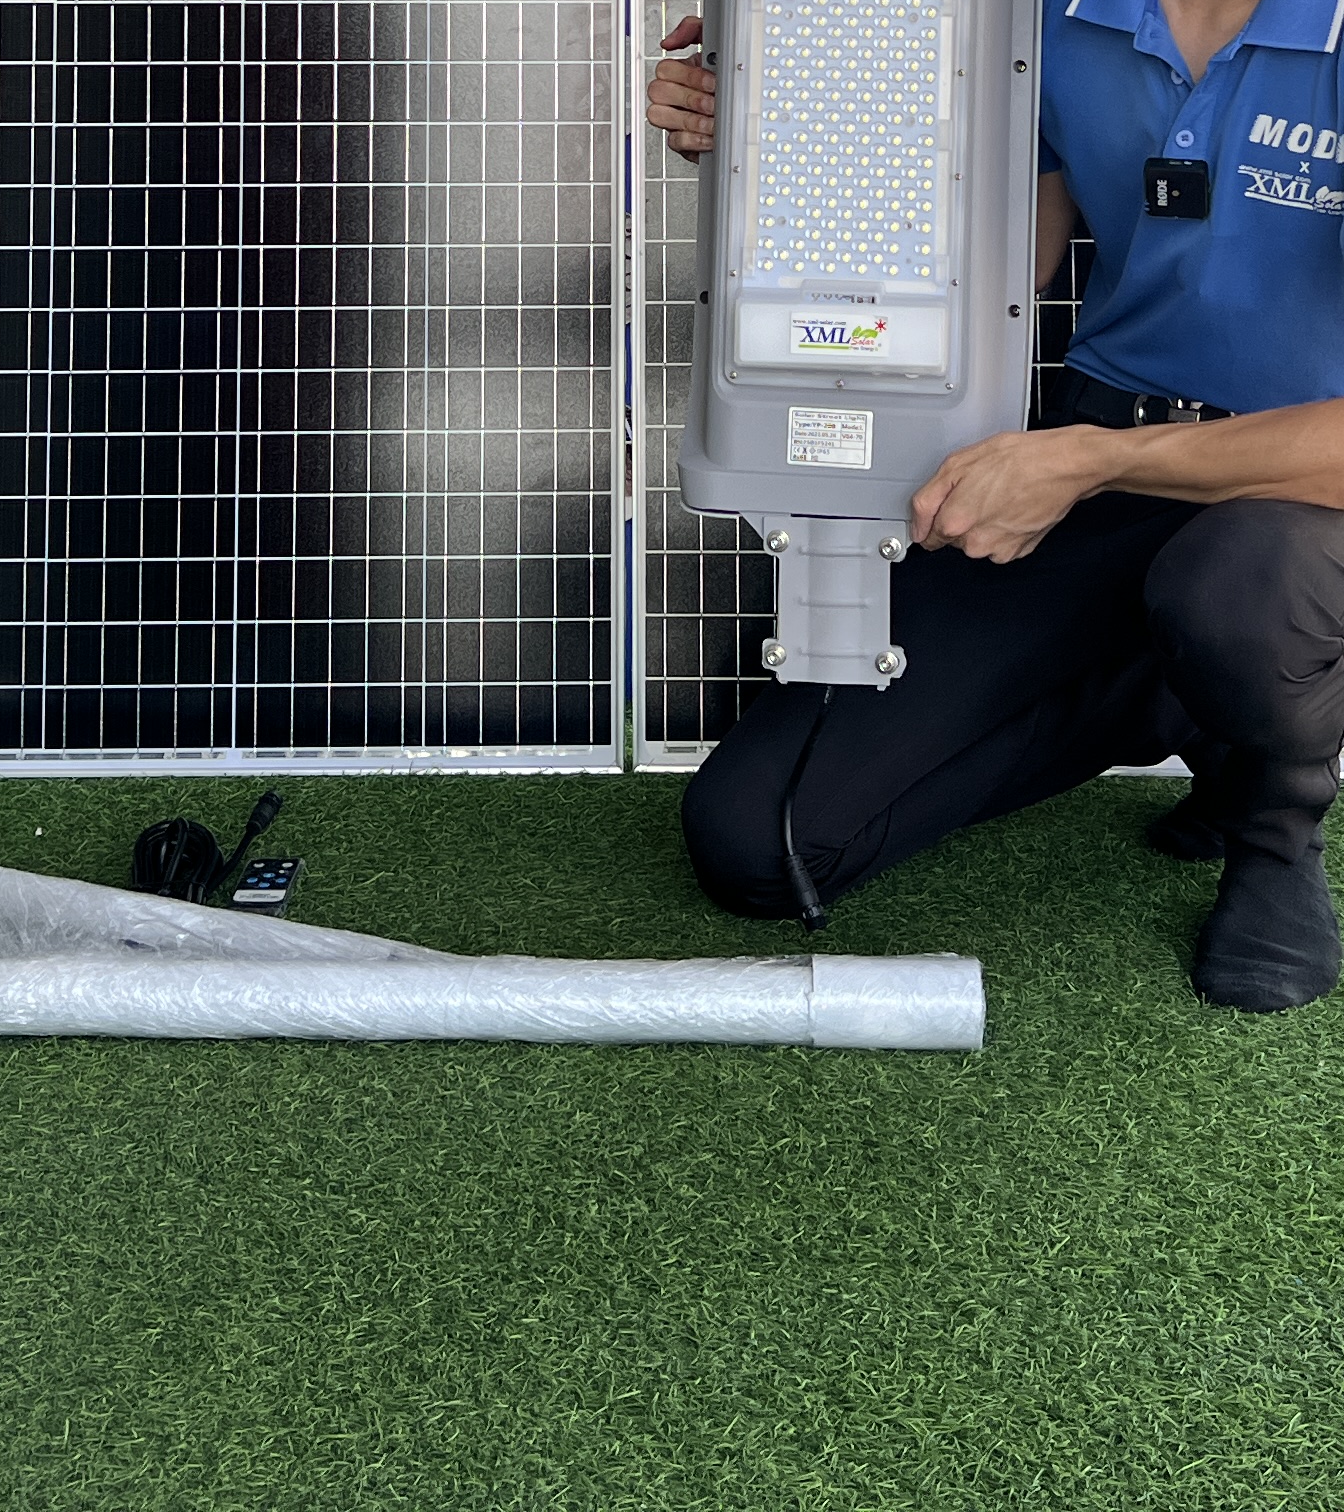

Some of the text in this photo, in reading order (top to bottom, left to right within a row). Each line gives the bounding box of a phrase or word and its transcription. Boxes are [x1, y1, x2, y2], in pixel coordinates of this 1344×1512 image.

[1156, 179, 1168, 207] RØDE
[1246, 173, 1315, 205] XML
[800, 326, 851, 344] XML
